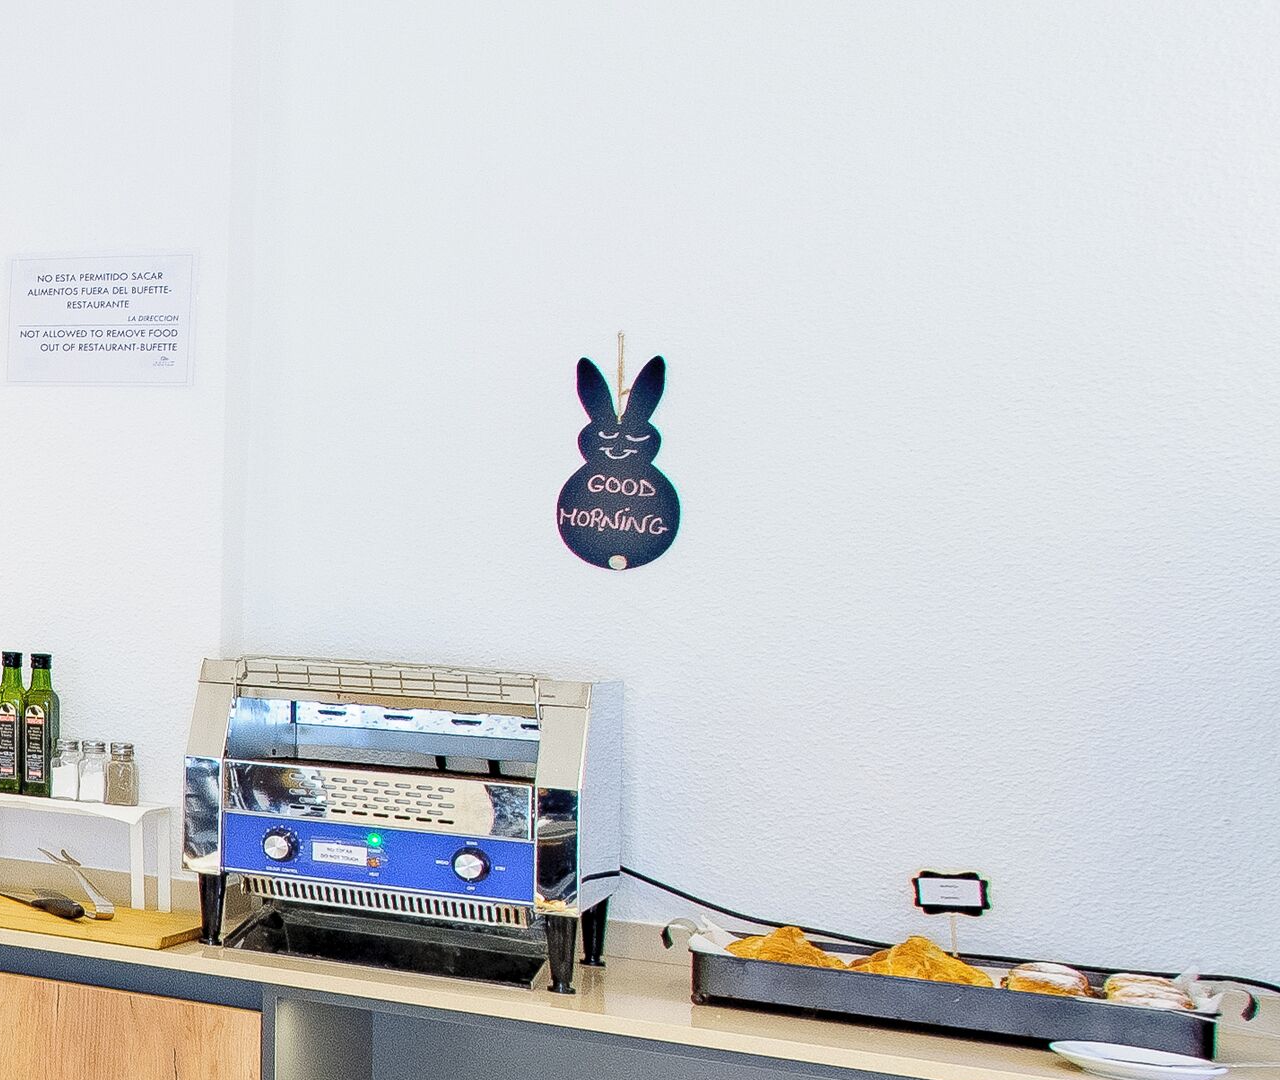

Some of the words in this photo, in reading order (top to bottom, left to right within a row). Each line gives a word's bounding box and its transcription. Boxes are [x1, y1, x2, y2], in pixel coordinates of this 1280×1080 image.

[37, 275, 53, 283] NO
[55, 274, 76, 283] ESTA
[79, 273, 128, 282] PERMITIDO
[131, 272, 163, 281] SACAR
[27, 287, 78, 296] ALIMENTOS
[81, 287, 109, 295] FUERA
[112, 287, 128, 295] DEL
[131, 286, 172, 294] BUFETTE-
[66, 300, 130, 309] RESTAURANTE
[20, 330, 40, 338] NOT
[42, 330, 88, 338] ALLOWED
[90, 329, 103, 338] TO
[106, 329, 146, 338] REMOVE
[148, 329, 178, 337] FOOD
[40, 343, 61, 352] OUT
[63, 343, 75, 352] OF
[78, 343, 178, 352] RESTAURANT-BUFETTE
[587, 473, 656, 497] GOOD
